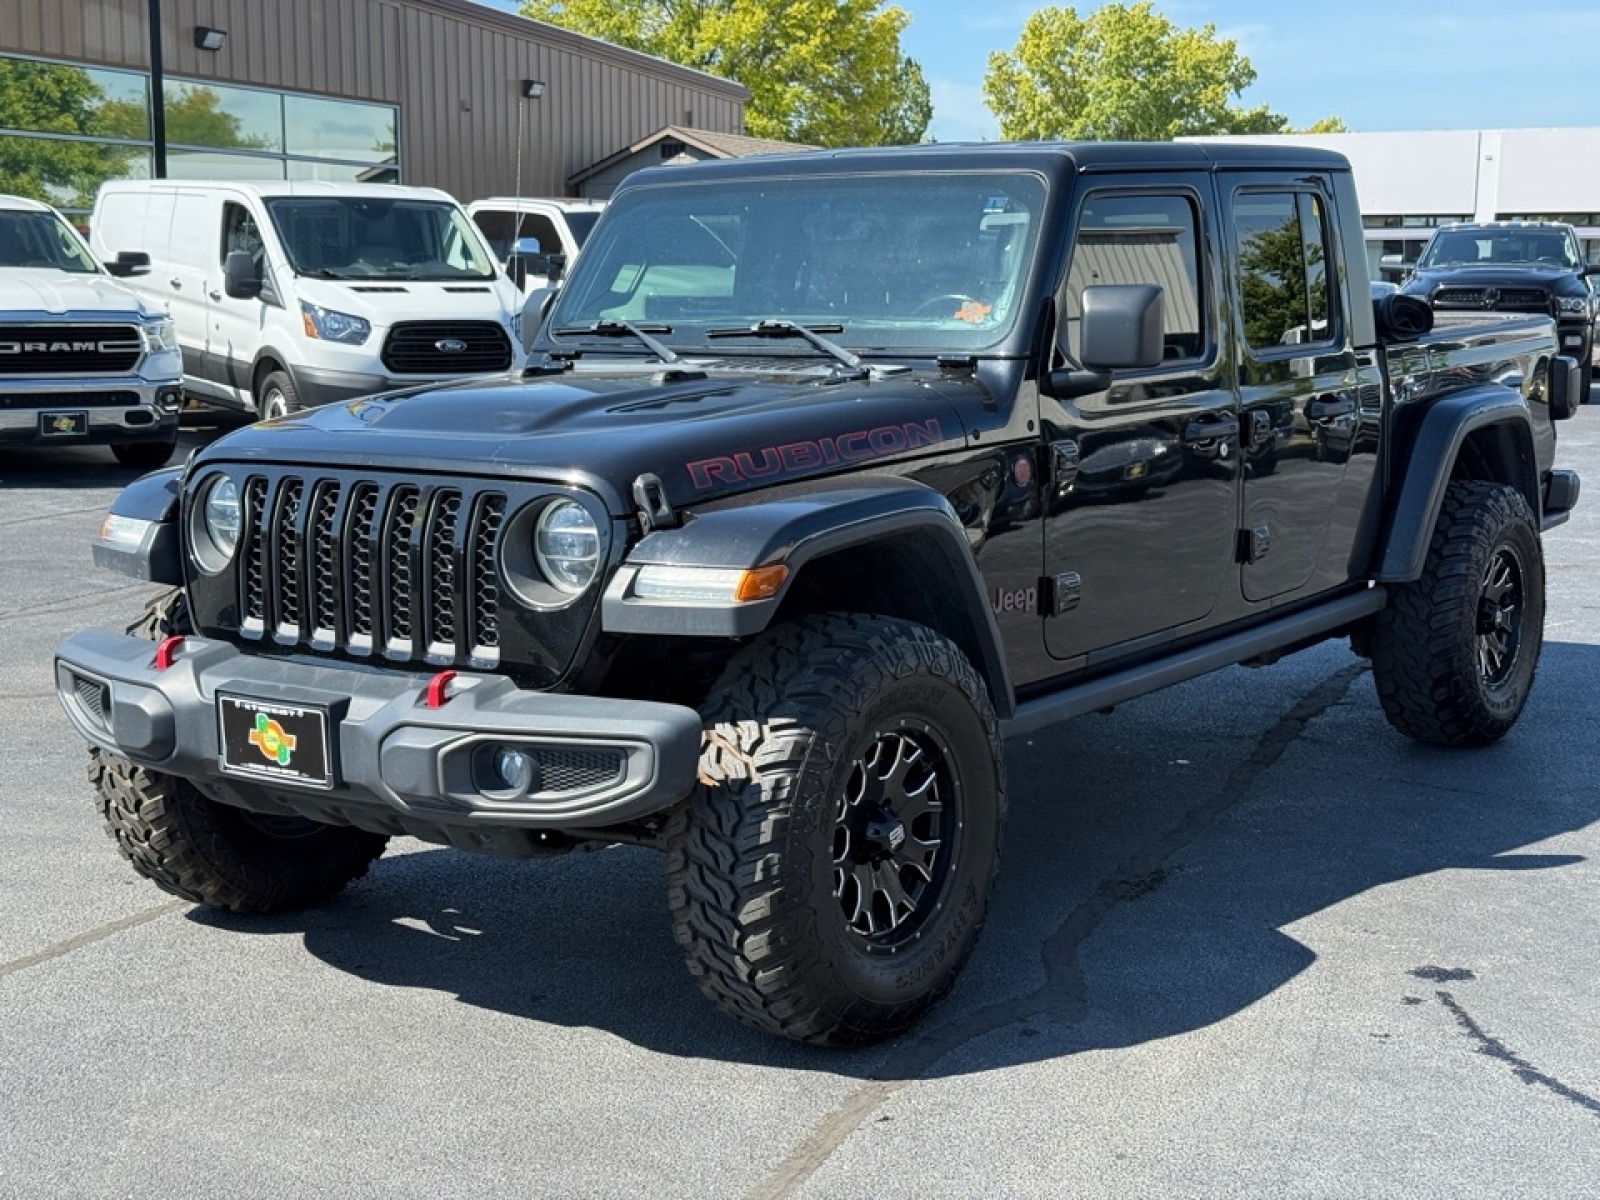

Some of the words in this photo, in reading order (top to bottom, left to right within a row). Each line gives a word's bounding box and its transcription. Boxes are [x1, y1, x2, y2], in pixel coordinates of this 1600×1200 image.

[24, 342, 96, 351] RAM
[686, 418, 943, 490] RUBICON
[993, 587, 1036, 613] Jeep
